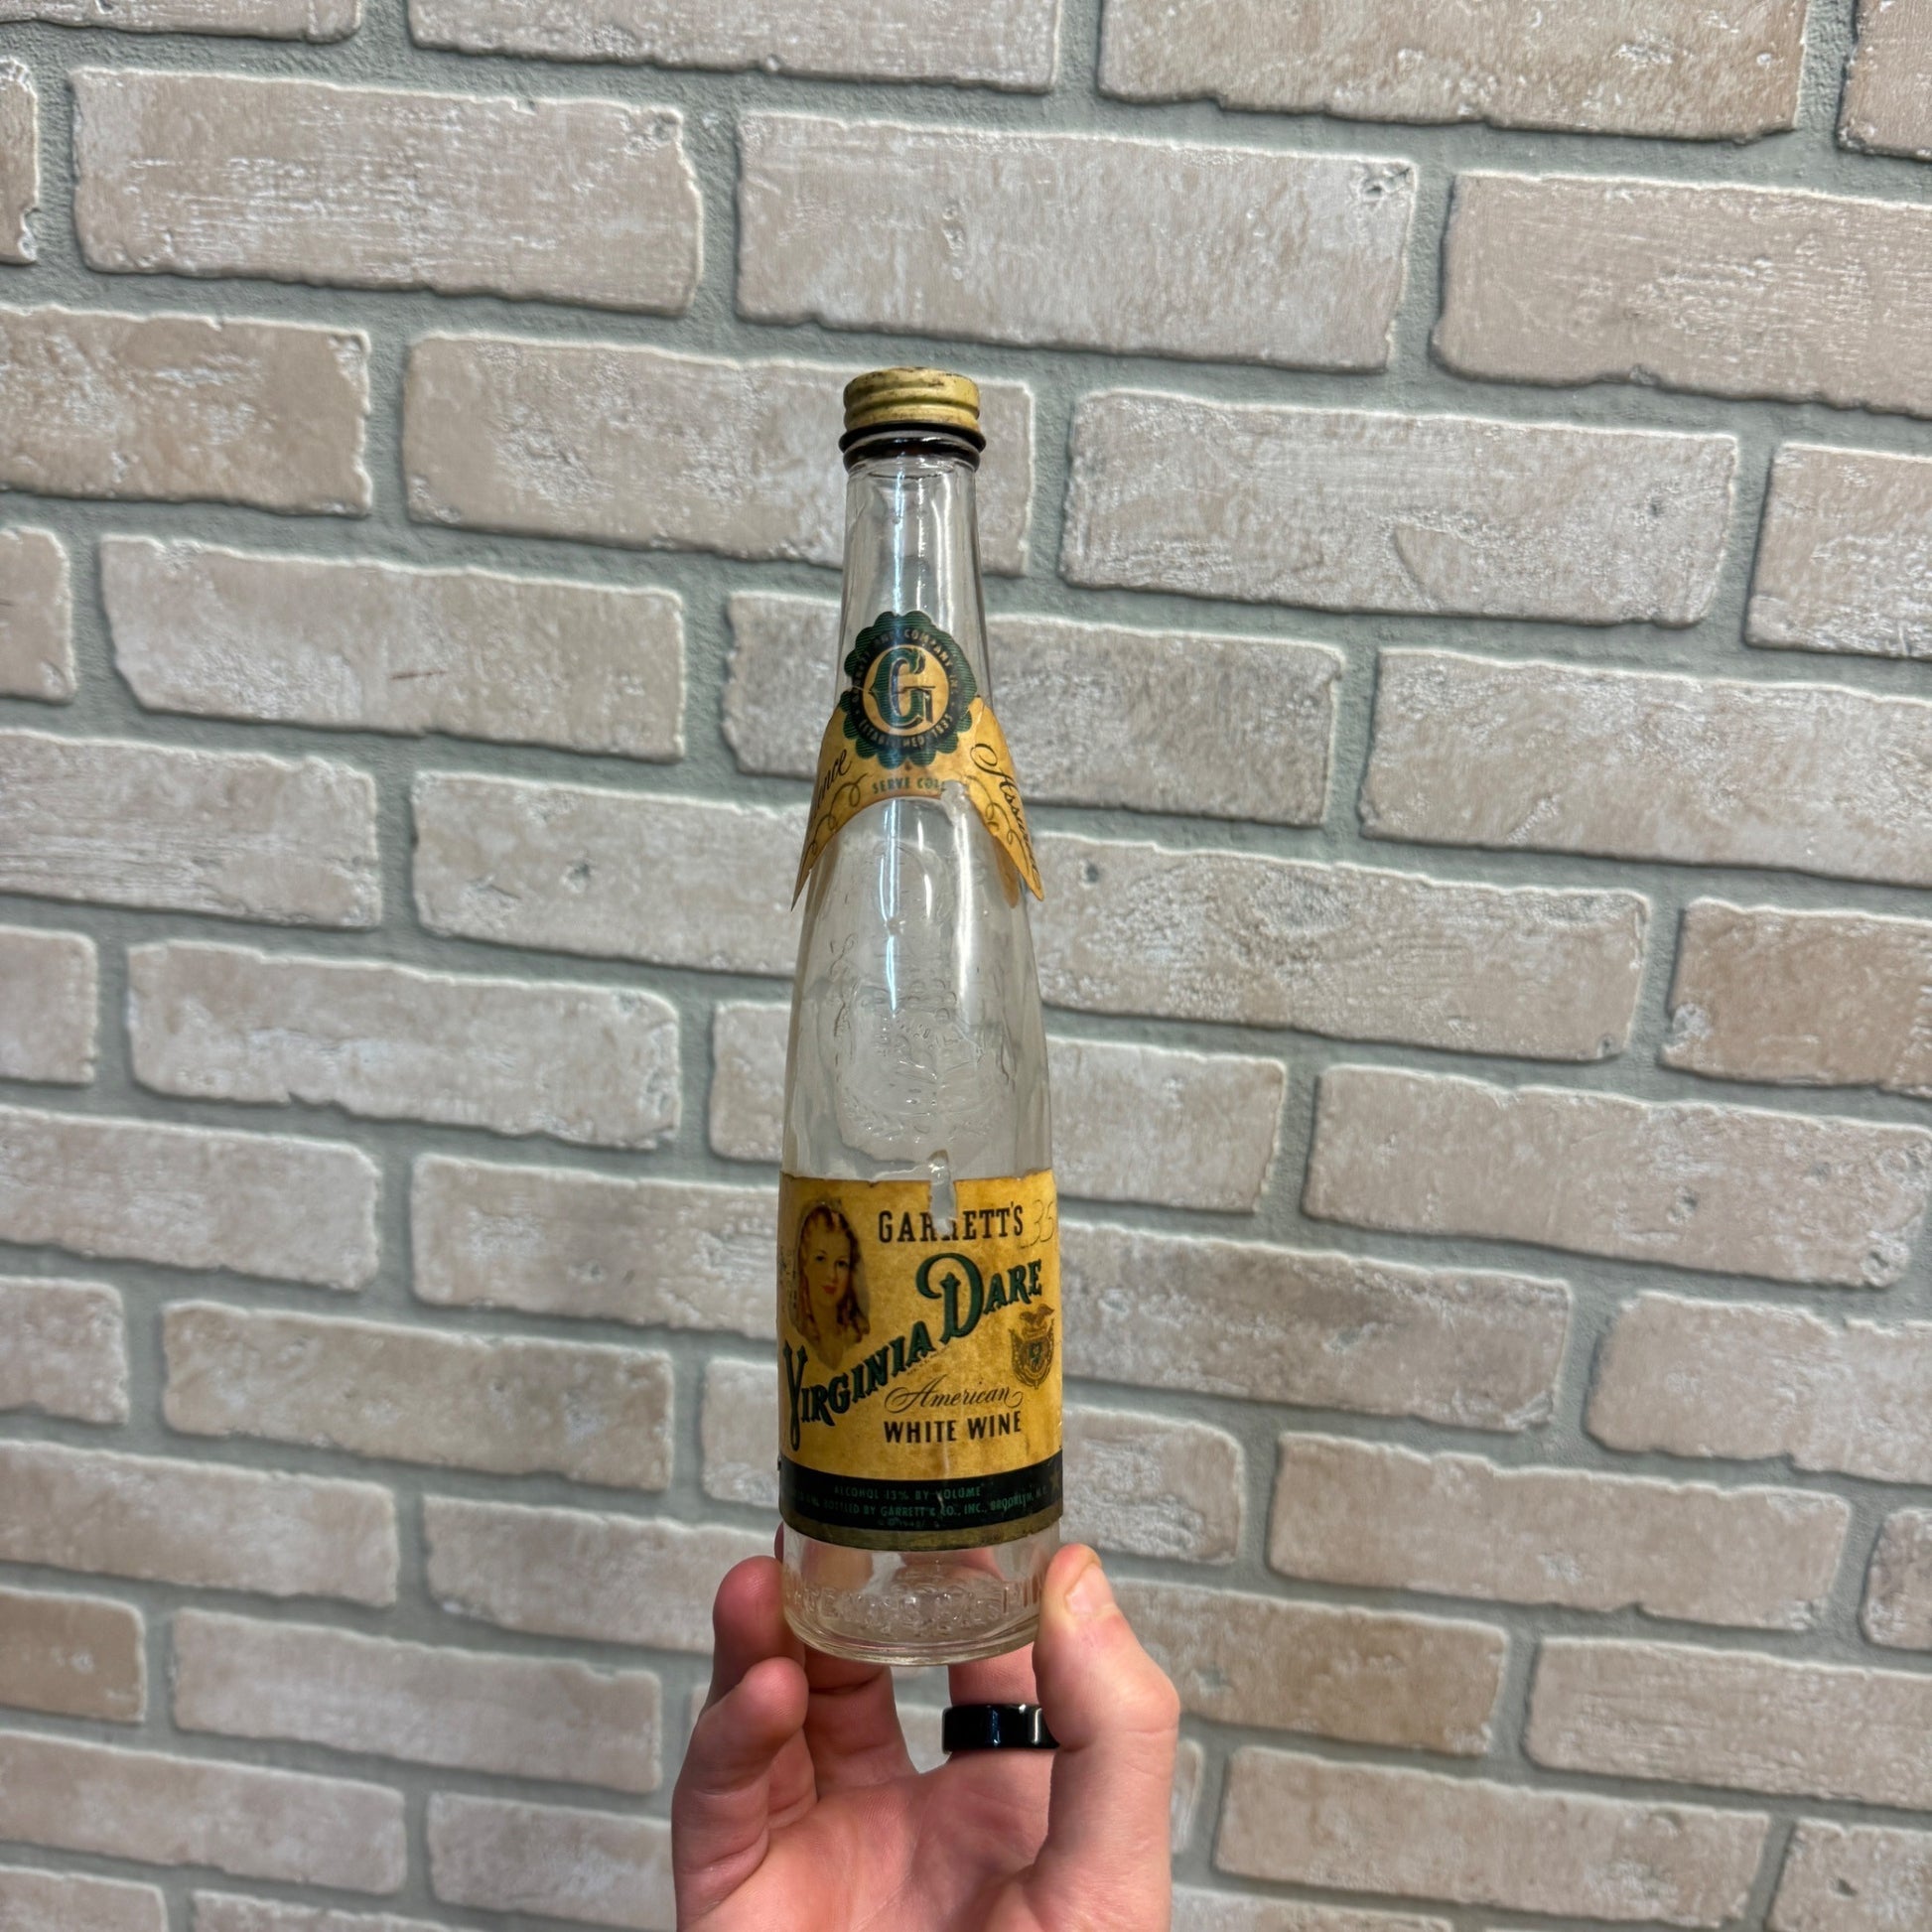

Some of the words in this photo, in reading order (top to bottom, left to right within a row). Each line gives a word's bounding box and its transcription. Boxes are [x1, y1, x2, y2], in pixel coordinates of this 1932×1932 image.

[869, 648, 934, 729] G
[873, 777, 910, 794] SERVE
[782, 1320, 936, 1452] VIRGINIA
[915, 1252, 1042, 1343] DARE
[884, 1374, 1024, 1414] American
[884, 1420, 956, 1444] WHITE
[967, 1411, 1022, 1441] WINE
[914, 1490, 929, 1500] BY
